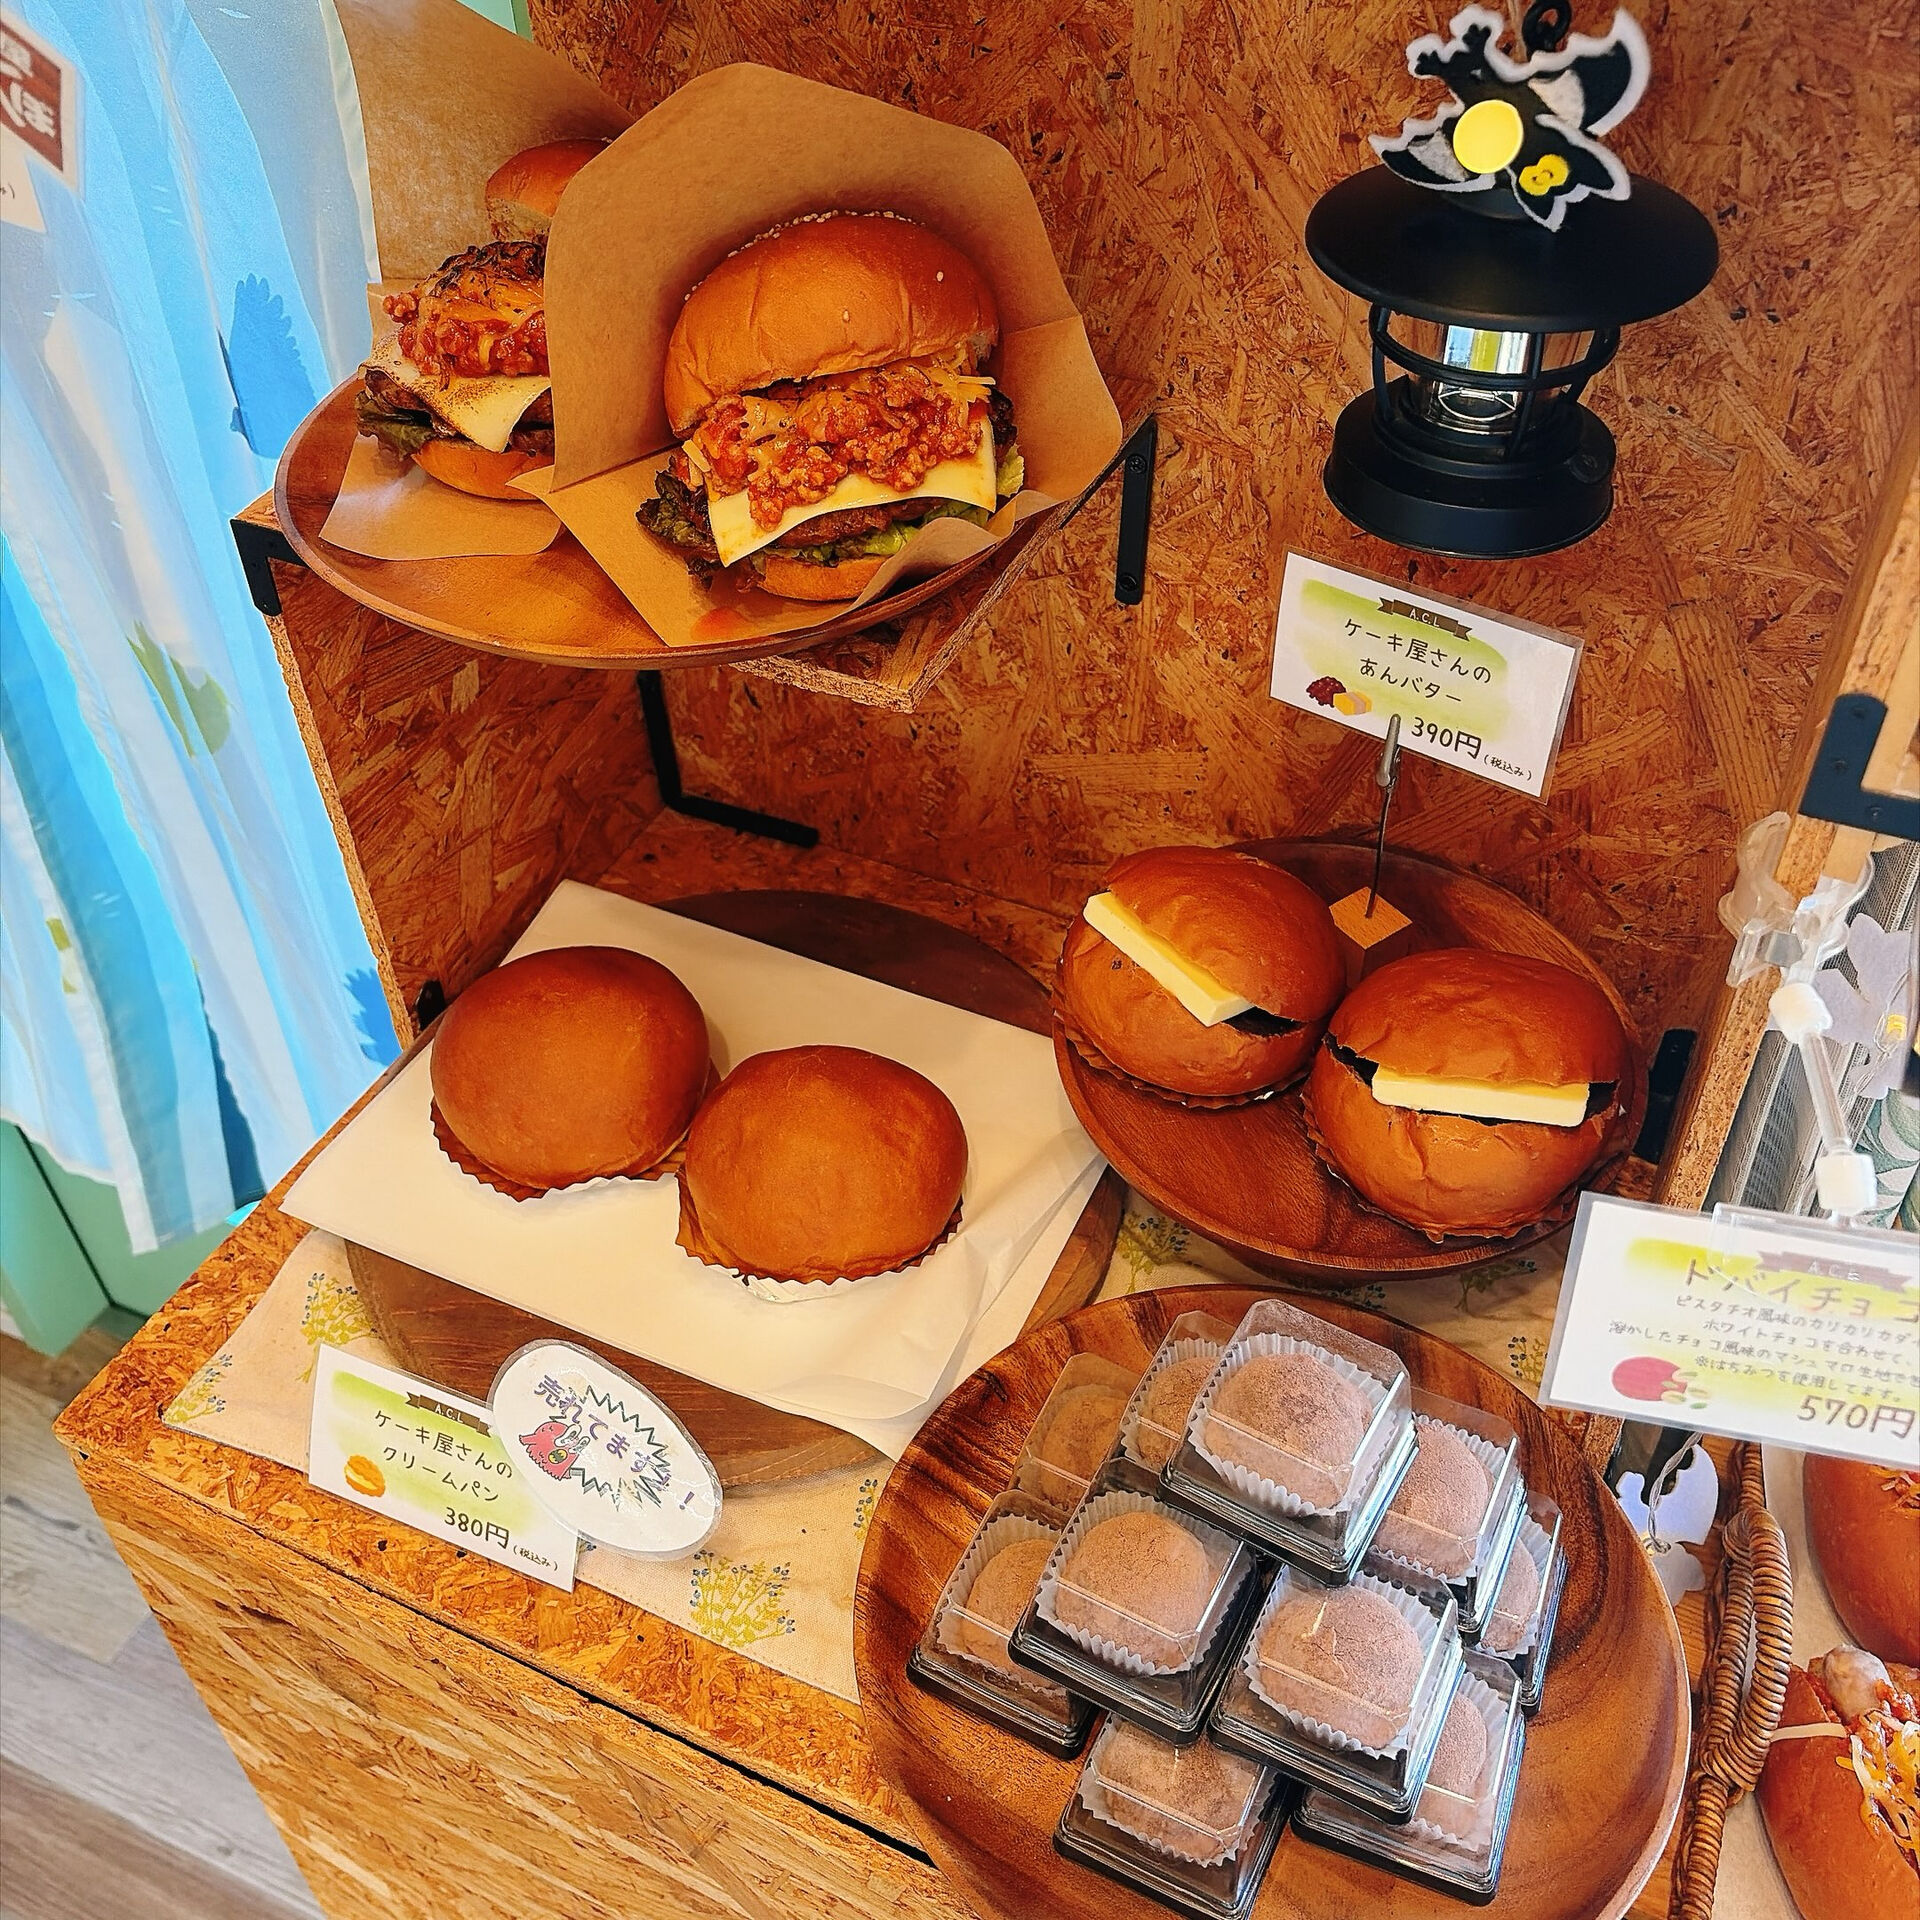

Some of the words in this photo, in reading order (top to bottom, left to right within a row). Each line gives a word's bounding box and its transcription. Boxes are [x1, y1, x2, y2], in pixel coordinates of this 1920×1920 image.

[1409, 608, 1440, 628] A.C.L
[1344, 619, 1491, 684] ケーキ屋さんの
[1360, 657, 1462, 702] あんバター
[1411, 716, 1482, 760] 390円
[435, 1402, 465, 1423] A.C.L
[1797, 1394, 1916, 1439] 570円
[375, 1409, 513, 1479] ケーキ屋さんの
[383, 1446, 500, 1503] クリームパン
[445, 1506, 510, 1551] 380円
